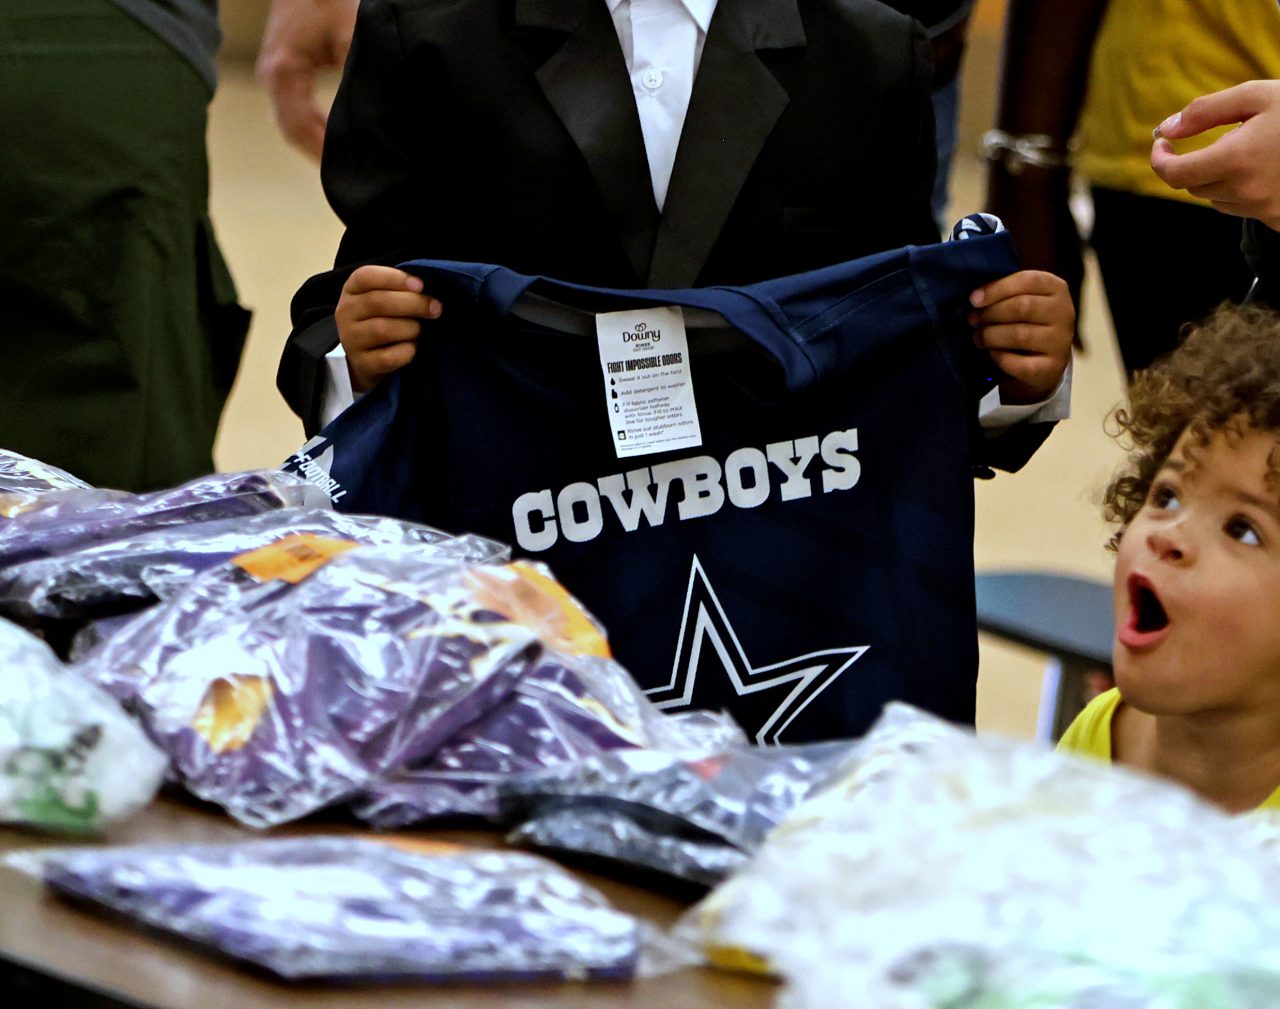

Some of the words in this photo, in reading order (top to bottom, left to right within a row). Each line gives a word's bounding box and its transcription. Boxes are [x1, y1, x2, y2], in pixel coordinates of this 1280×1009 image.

[622, 329, 661, 343] Downy
[607, 360, 624, 374] FIGHT
[625, 355, 661, 370] IMPOSSIBLE
[662, 352, 682, 366] ODORS
[294, 452, 348, 504] FOOTBALL
[512, 428, 861, 552] COWBOYS
